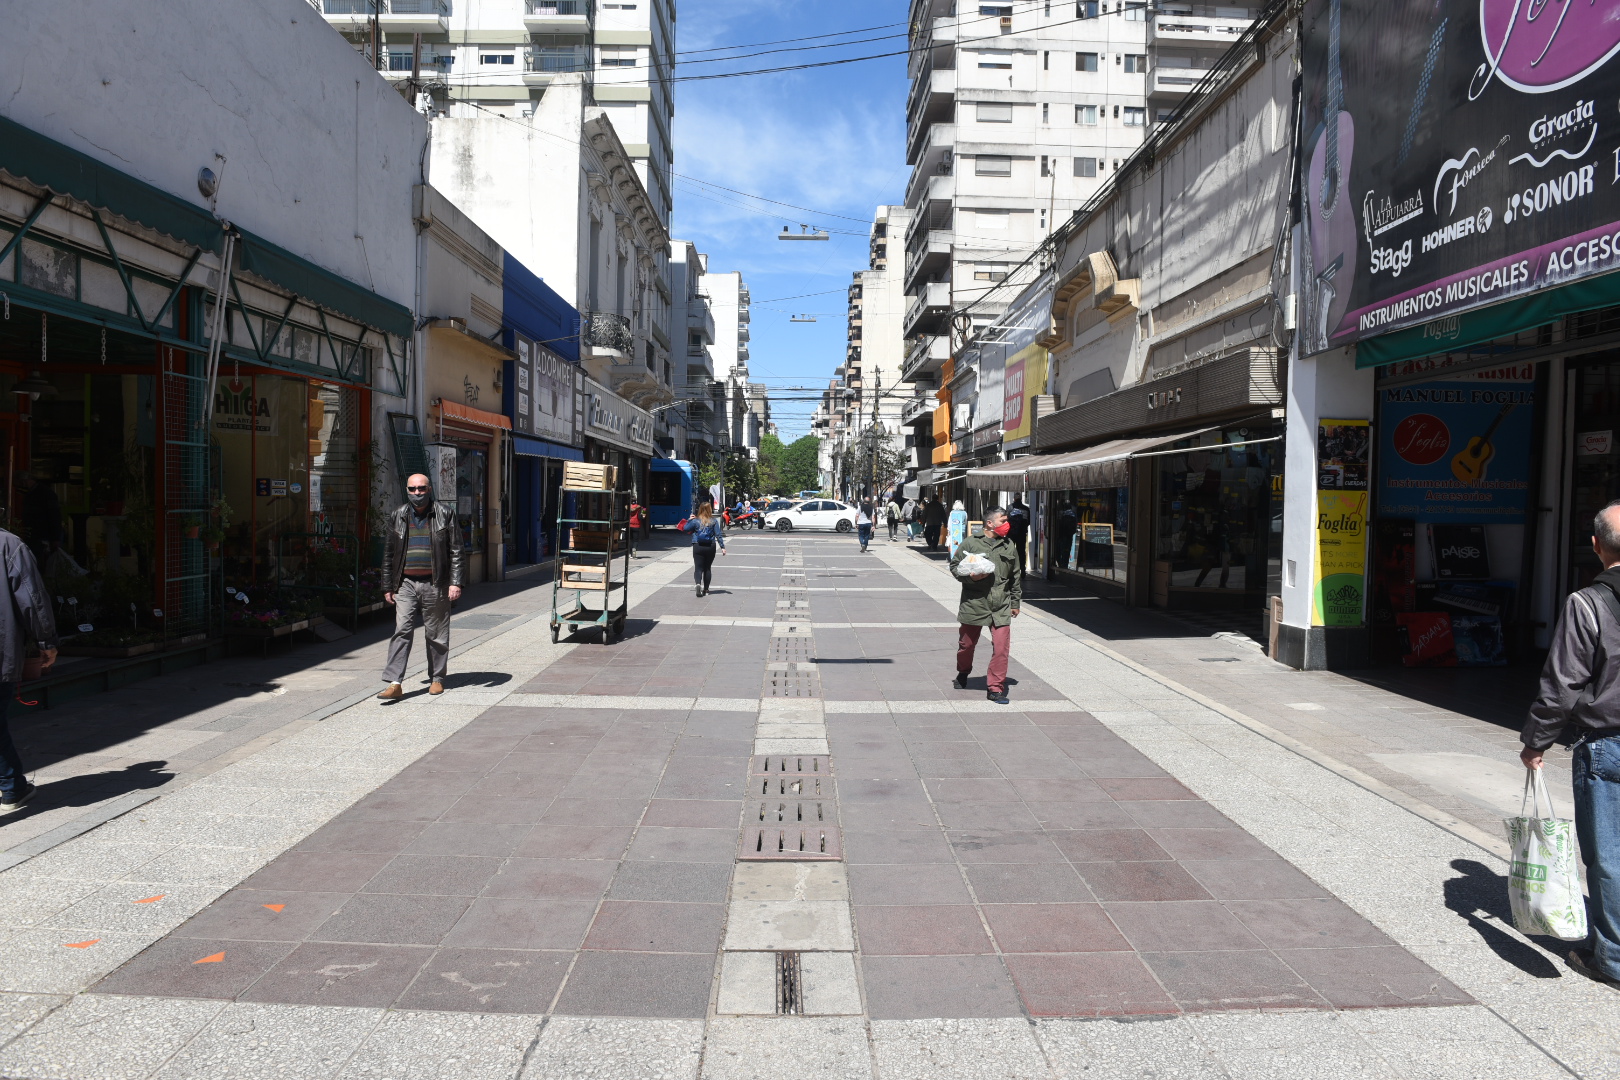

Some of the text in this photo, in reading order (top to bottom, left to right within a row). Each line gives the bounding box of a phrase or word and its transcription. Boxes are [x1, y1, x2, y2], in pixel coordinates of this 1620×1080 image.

[1529, 100, 1595, 144] Gracia
[1533, 119, 1593, 150] GUITARRAS
[1522, 164, 1594, 217] SONOR
[1421, 216, 1475, 254] HOHNER
[1370, 239, 1412, 278] Stagg
[1360, 287, 1442, 332] INSTRUMENTOS
[1445, 260, 1529, 304] MUSICALES
[1005, 369, 1023, 398] MULTI
[1387, 388, 1536, 405] MANUEL FOGLIA
[215, 394, 271, 417] HIGA
[1005, 395, 1021, 422] SHOP
[1387, 474, 1529, 490] Instrumentos Musicales
[1424, 490, 1493, 502] Accesorios
[1317, 513, 1357, 534] Foglia
[1345, 561, 1364, 569] PICK
[1329, 605, 1362, 614] DUNLOP
[1412, 624, 1442, 656] SABIAN
